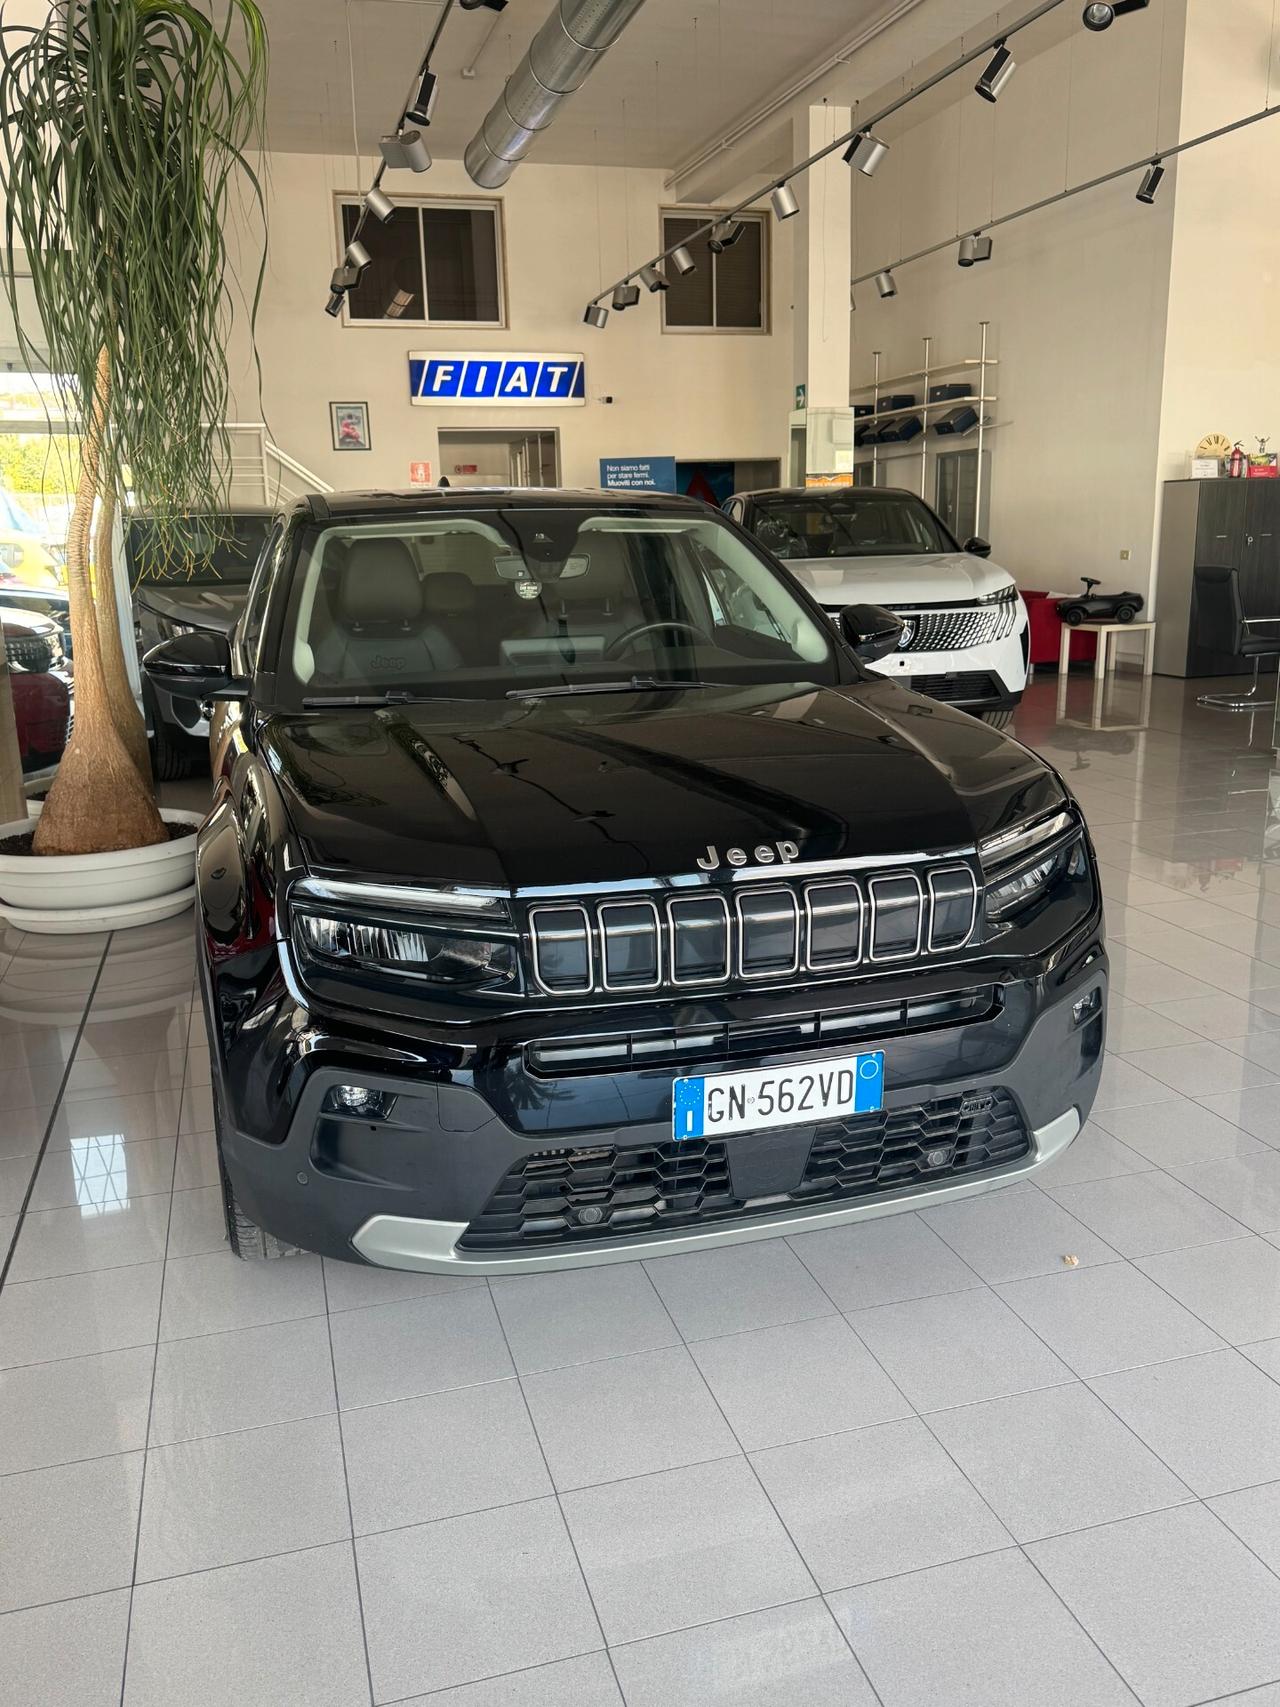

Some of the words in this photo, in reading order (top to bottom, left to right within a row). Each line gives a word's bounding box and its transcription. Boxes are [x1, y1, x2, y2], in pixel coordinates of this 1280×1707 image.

[432, 365, 569, 393] FIAT
[607, 464, 620, 472] Non
[696, 840, 799, 870] Jeep
[707, 1083, 746, 1123] GN
[757, 1069, 854, 1116] 562VD
